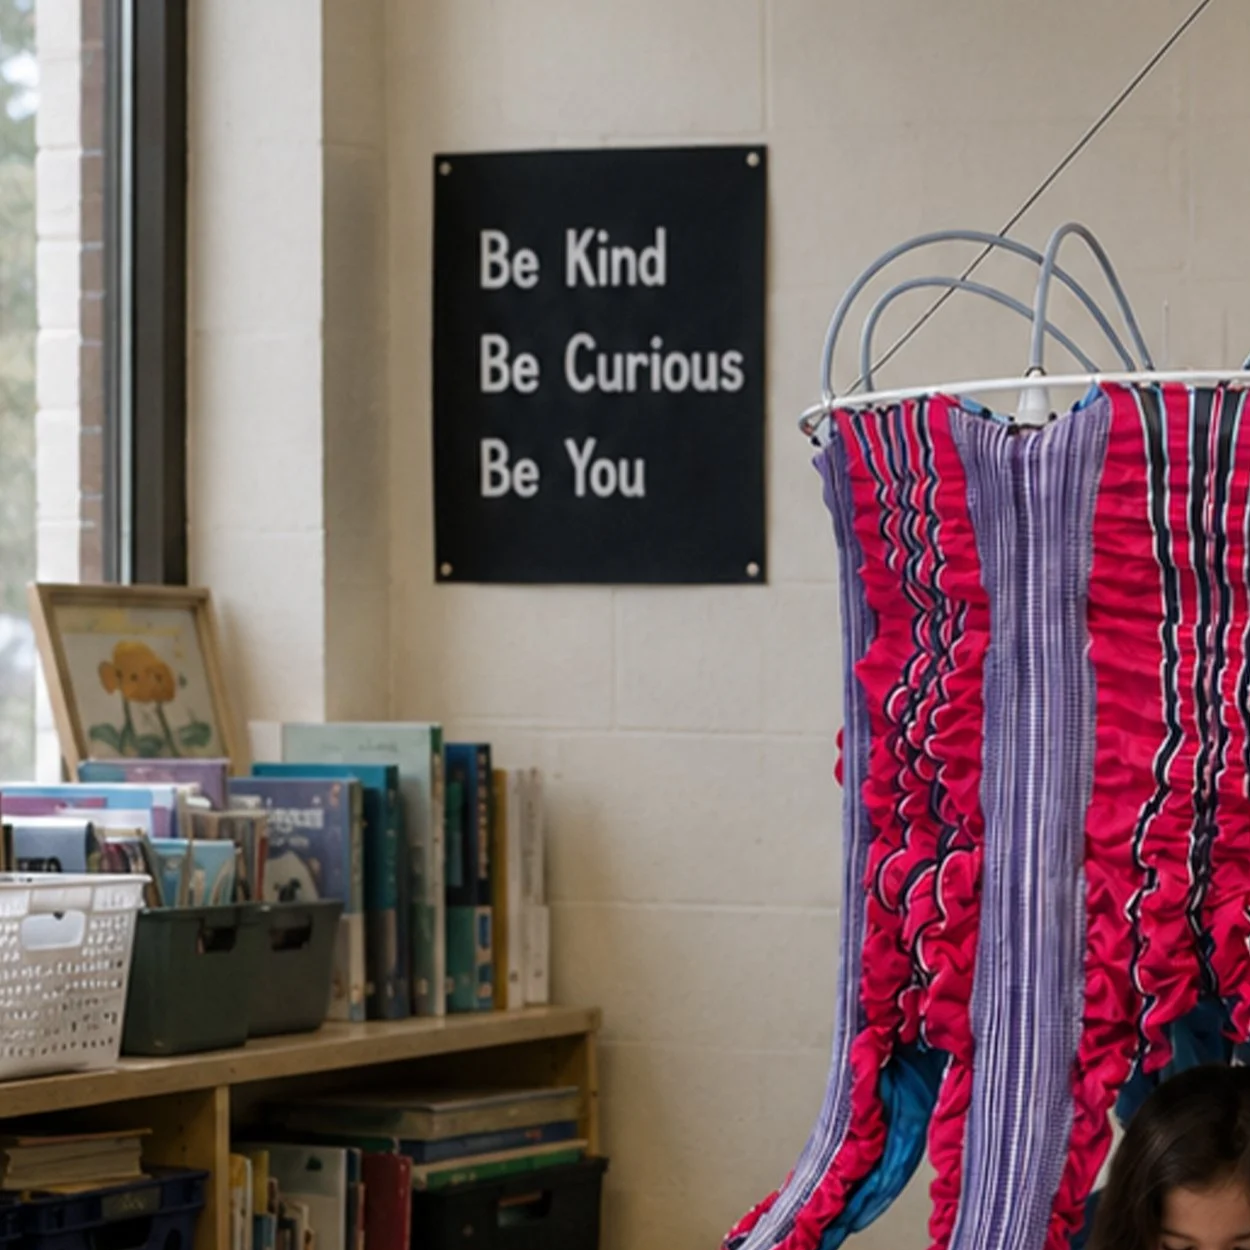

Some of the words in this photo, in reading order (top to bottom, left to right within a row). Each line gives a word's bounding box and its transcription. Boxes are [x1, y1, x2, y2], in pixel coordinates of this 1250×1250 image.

[480, 229, 540, 289] Be
[565, 226, 667, 288] Kind
[480, 333, 540, 393] Be
[564, 332, 745, 393] Curious
[480, 438, 540, 498] Be
[564, 436, 647, 498] You
